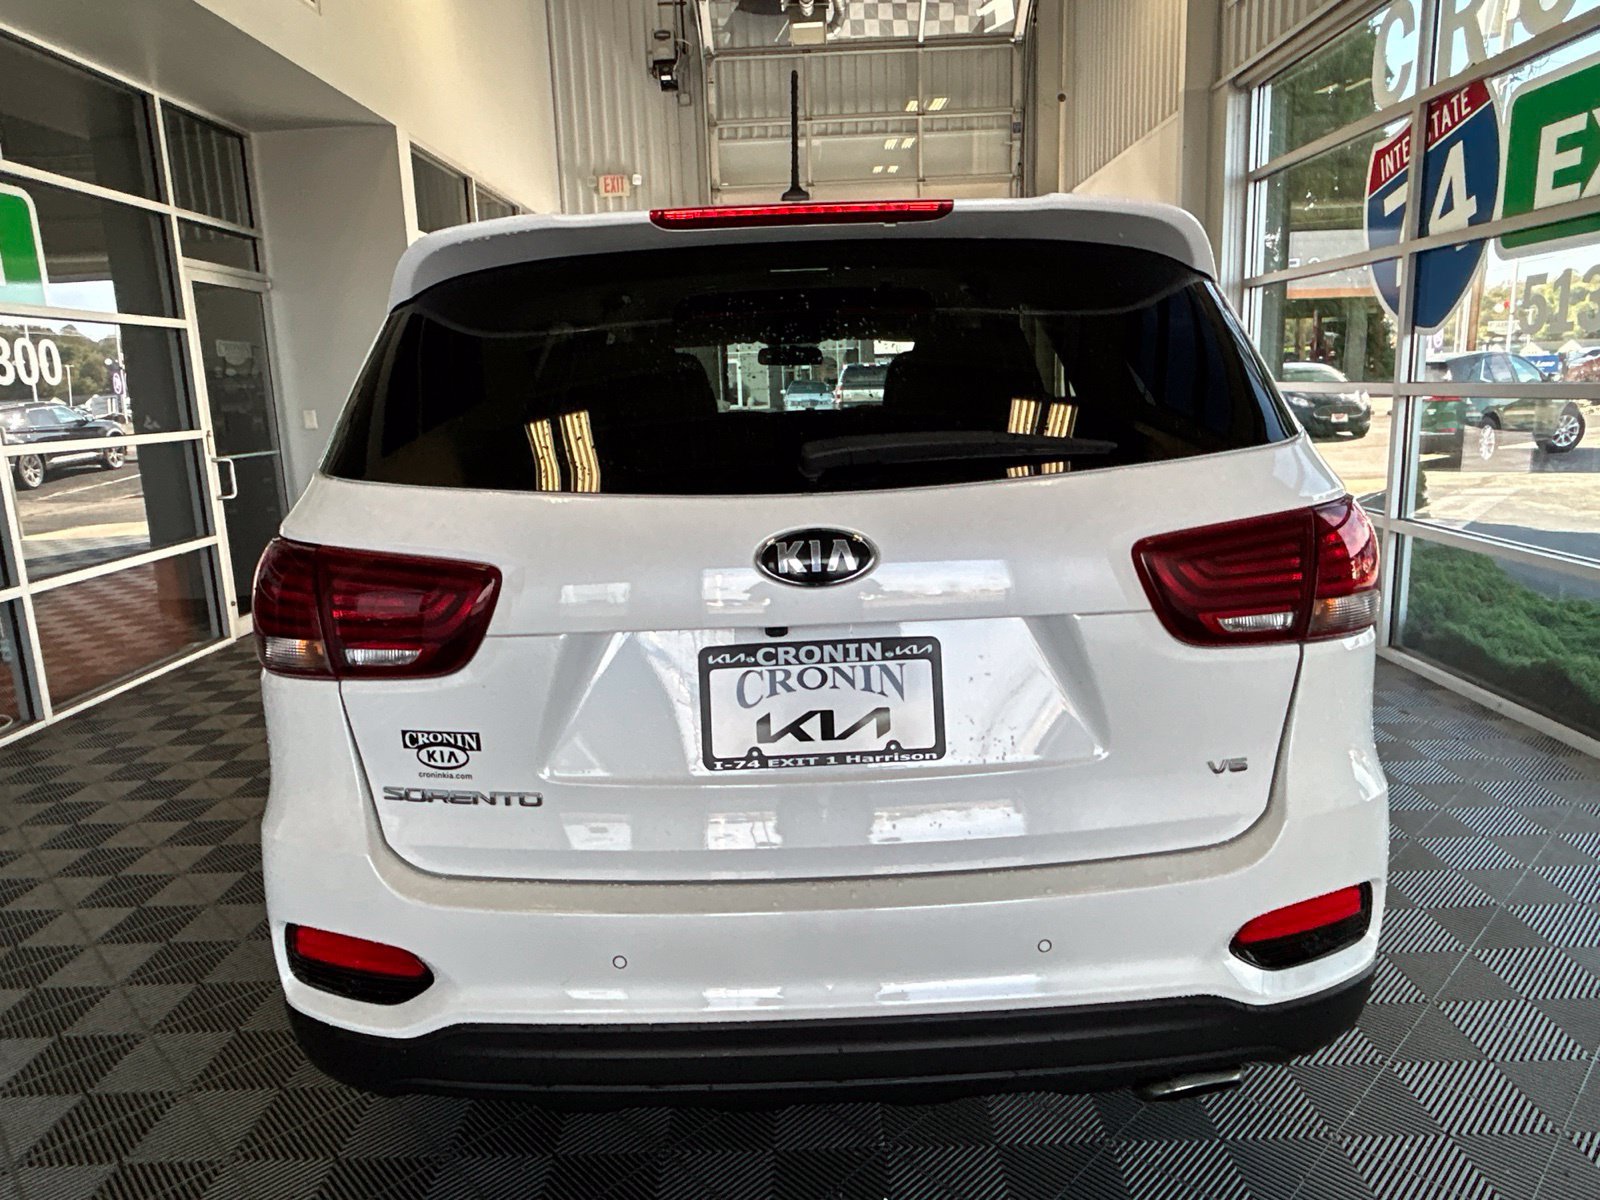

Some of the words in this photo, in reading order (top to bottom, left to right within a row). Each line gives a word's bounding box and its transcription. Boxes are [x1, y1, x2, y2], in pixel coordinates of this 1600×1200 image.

[1380, 87, 1471, 182] INTETATE
[603, 175, 625, 193] EXIT
[775, 539, 858, 573] KIA
[707, 652, 745, 666] KIA
[755, 641, 883, 667] CRONIN
[894, 643, 933, 656] KIA
[736, 662, 906, 709] CRONIN
[756, 706, 891, 744] KIA
[404, 731, 478, 751] CRONIN
[426, 750, 460, 764] KIA
[713, 759, 761, 770] I-74
[768, 756, 819, 768] EXIT
[826, 755, 839, 765] 1
[845, 751, 938, 766] Harrison
[1206, 757, 1248, 774] V6
[418, 771, 473, 781] croninkia.com
[382, 786, 544, 807] SORENTO
